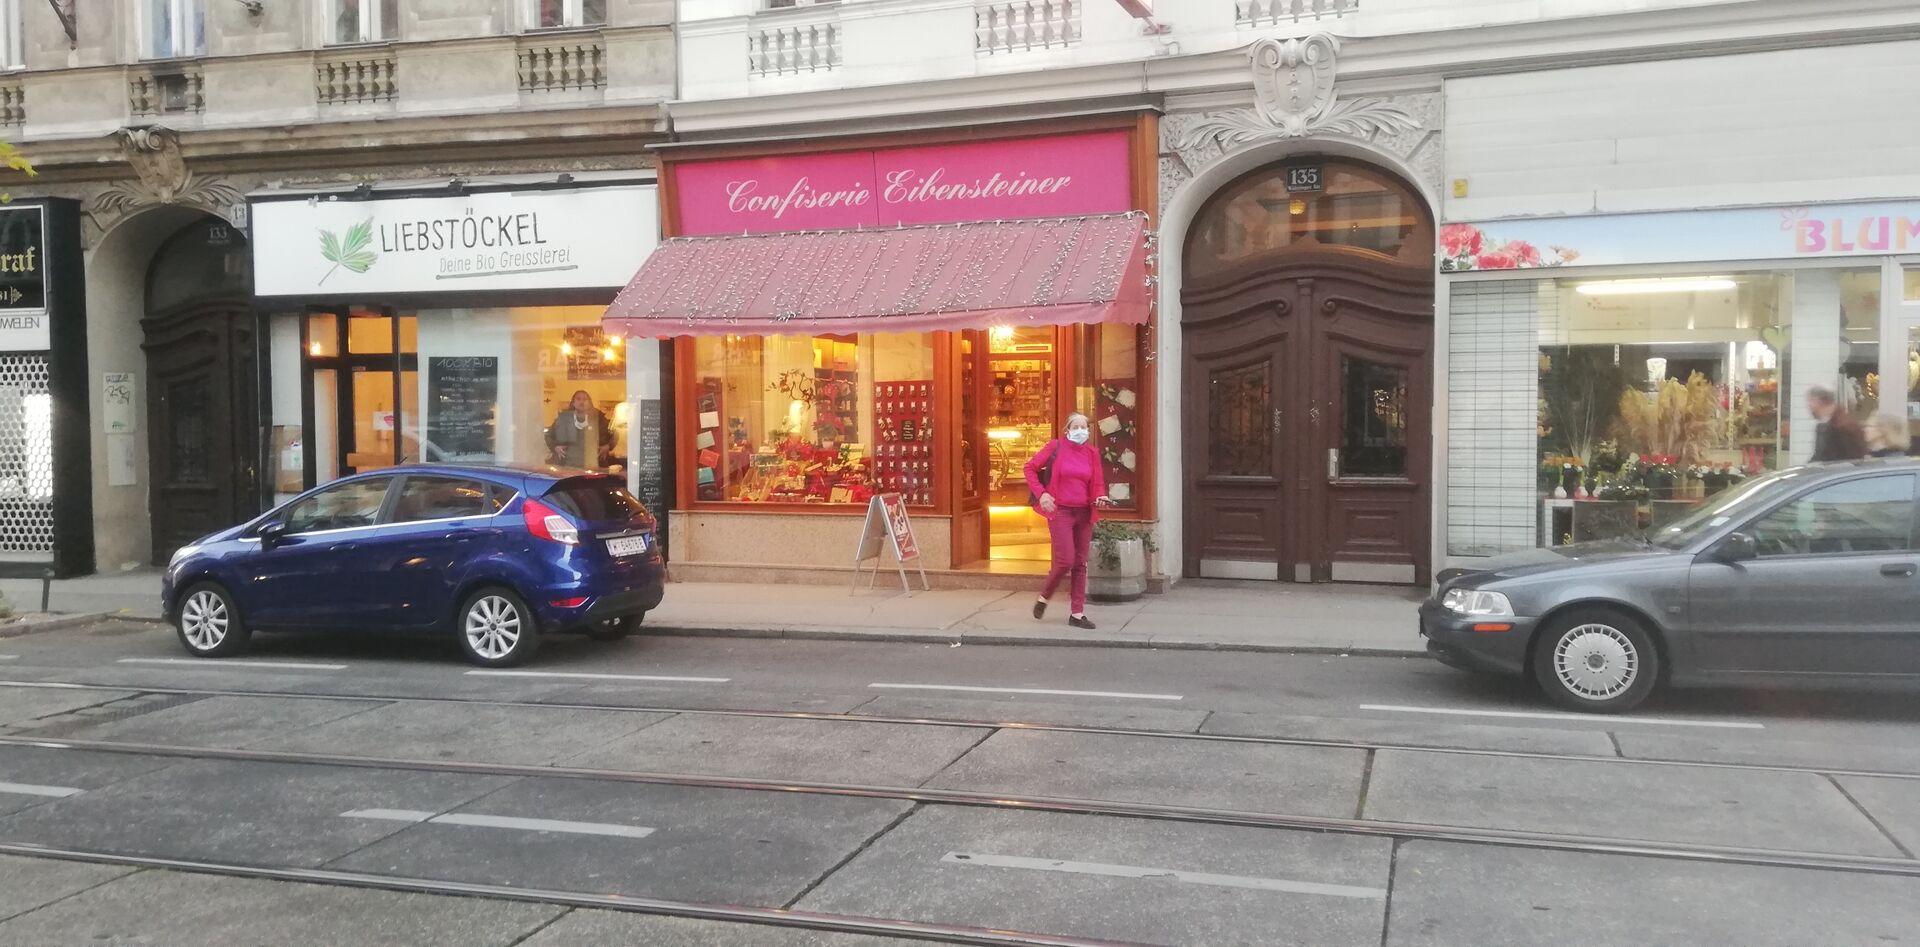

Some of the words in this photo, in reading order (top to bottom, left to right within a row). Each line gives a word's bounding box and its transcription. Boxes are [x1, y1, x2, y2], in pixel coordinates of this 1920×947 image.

[1291, 168, 1318, 185] 135
[726, 177, 870, 218] Confiserie
[884, 168, 1071, 204] Eibensteiner
[209, 225, 227, 239] 133
[380, 207, 547, 252] LIEBSTÖCKEL
[1, 246, 36, 273] raf
[439, 256, 471, 273] Deine
[476, 255, 495, 270] Bio
[500, 246, 570, 267] Greisslerei
[473, 358, 493, 368] BIO
